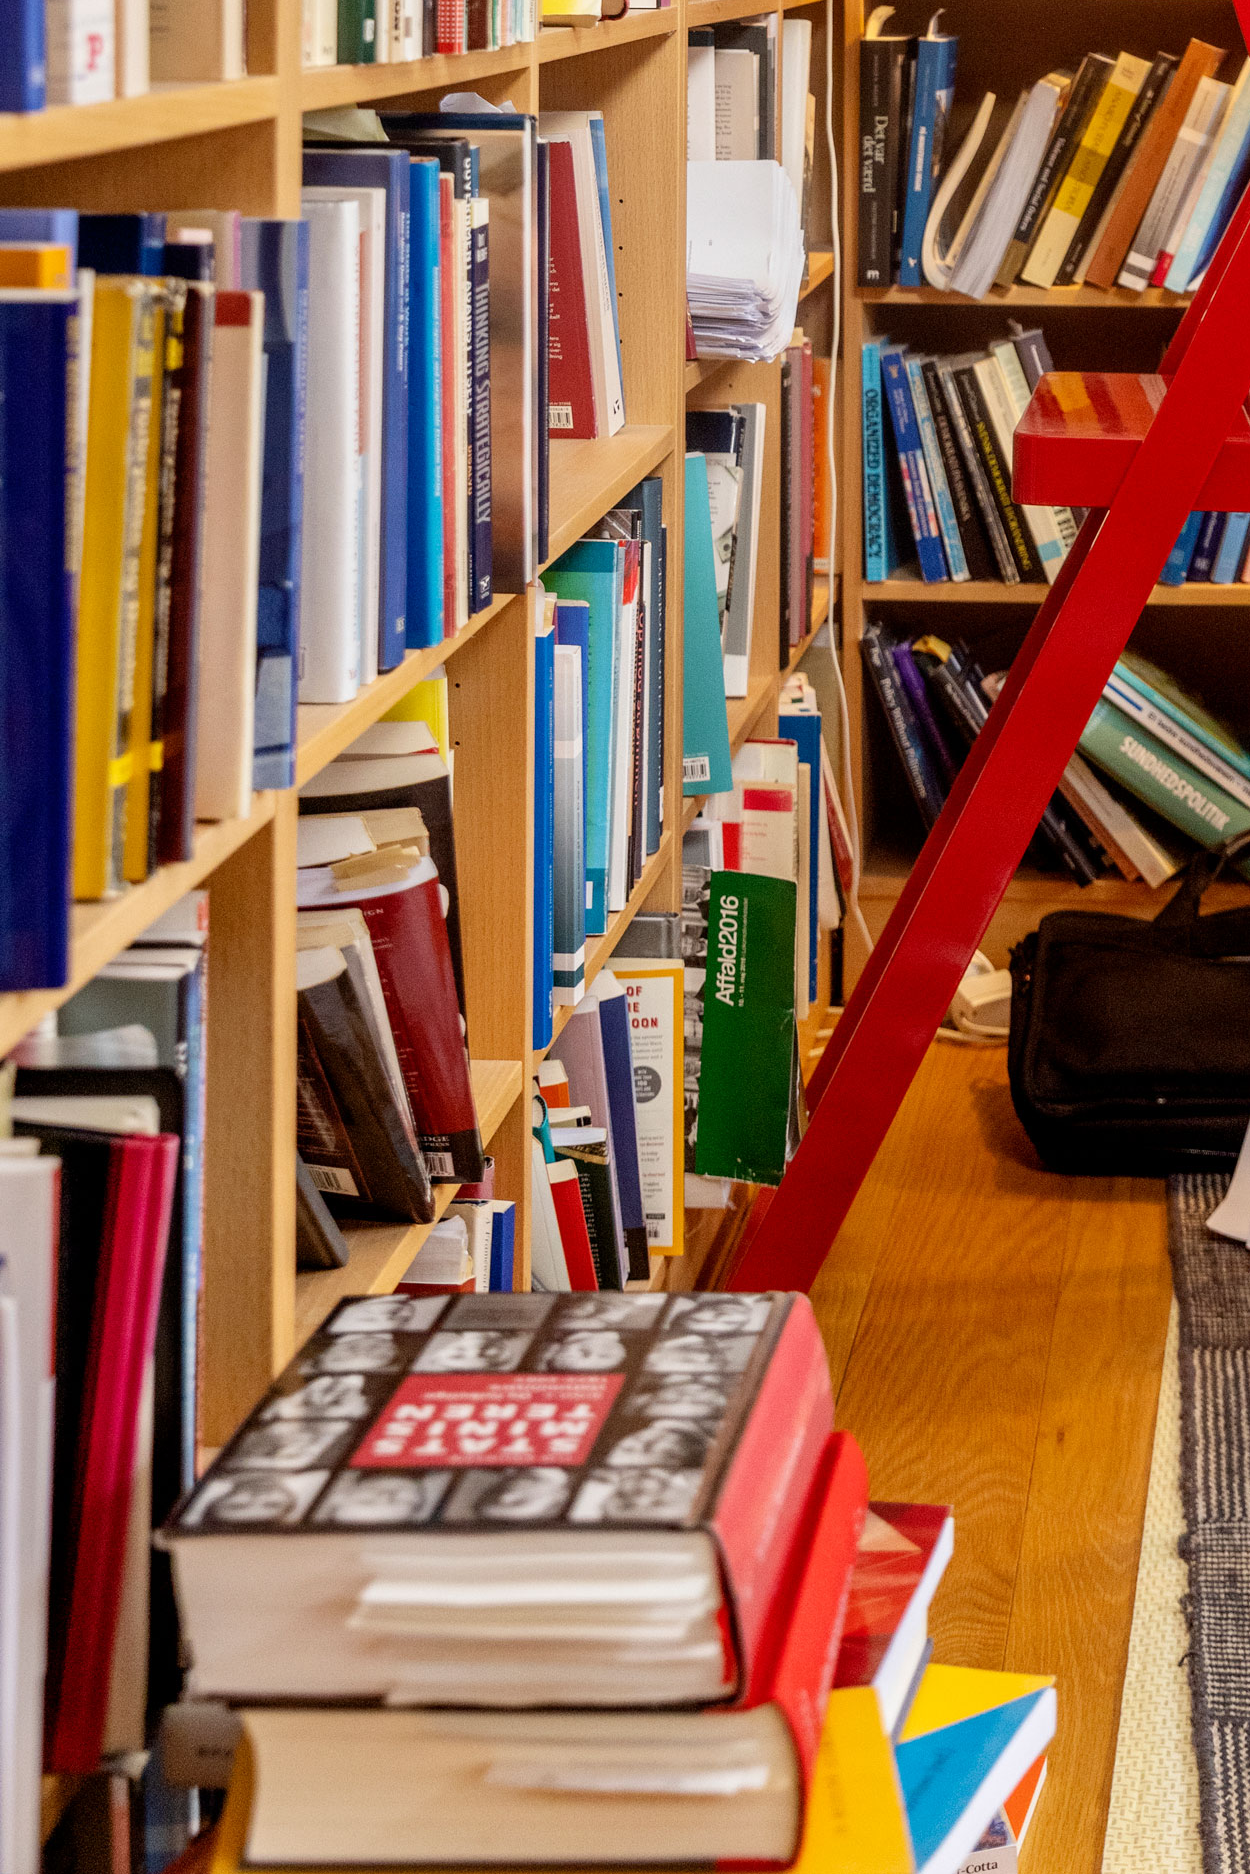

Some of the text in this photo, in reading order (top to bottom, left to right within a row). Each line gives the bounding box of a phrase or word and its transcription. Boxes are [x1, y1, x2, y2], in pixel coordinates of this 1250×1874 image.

[862, 135, 875, 193] det værd
[873, 115, 888, 165] Det var
[474, 280, 490, 526] THINKING STRATEGICALLY
[865, 388, 882, 560] ORGANIZED DEMOCRACY
[867, 645, 930, 799] Page Policy Without Politicians
[1117, 733, 1231, 832] SUNDHEDSPOLITIK
[715, 894, 740, 1008] Affald2016
[370, 1435, 591, 1457] STATS
[378, 1417, 596, 1440] MINIS
